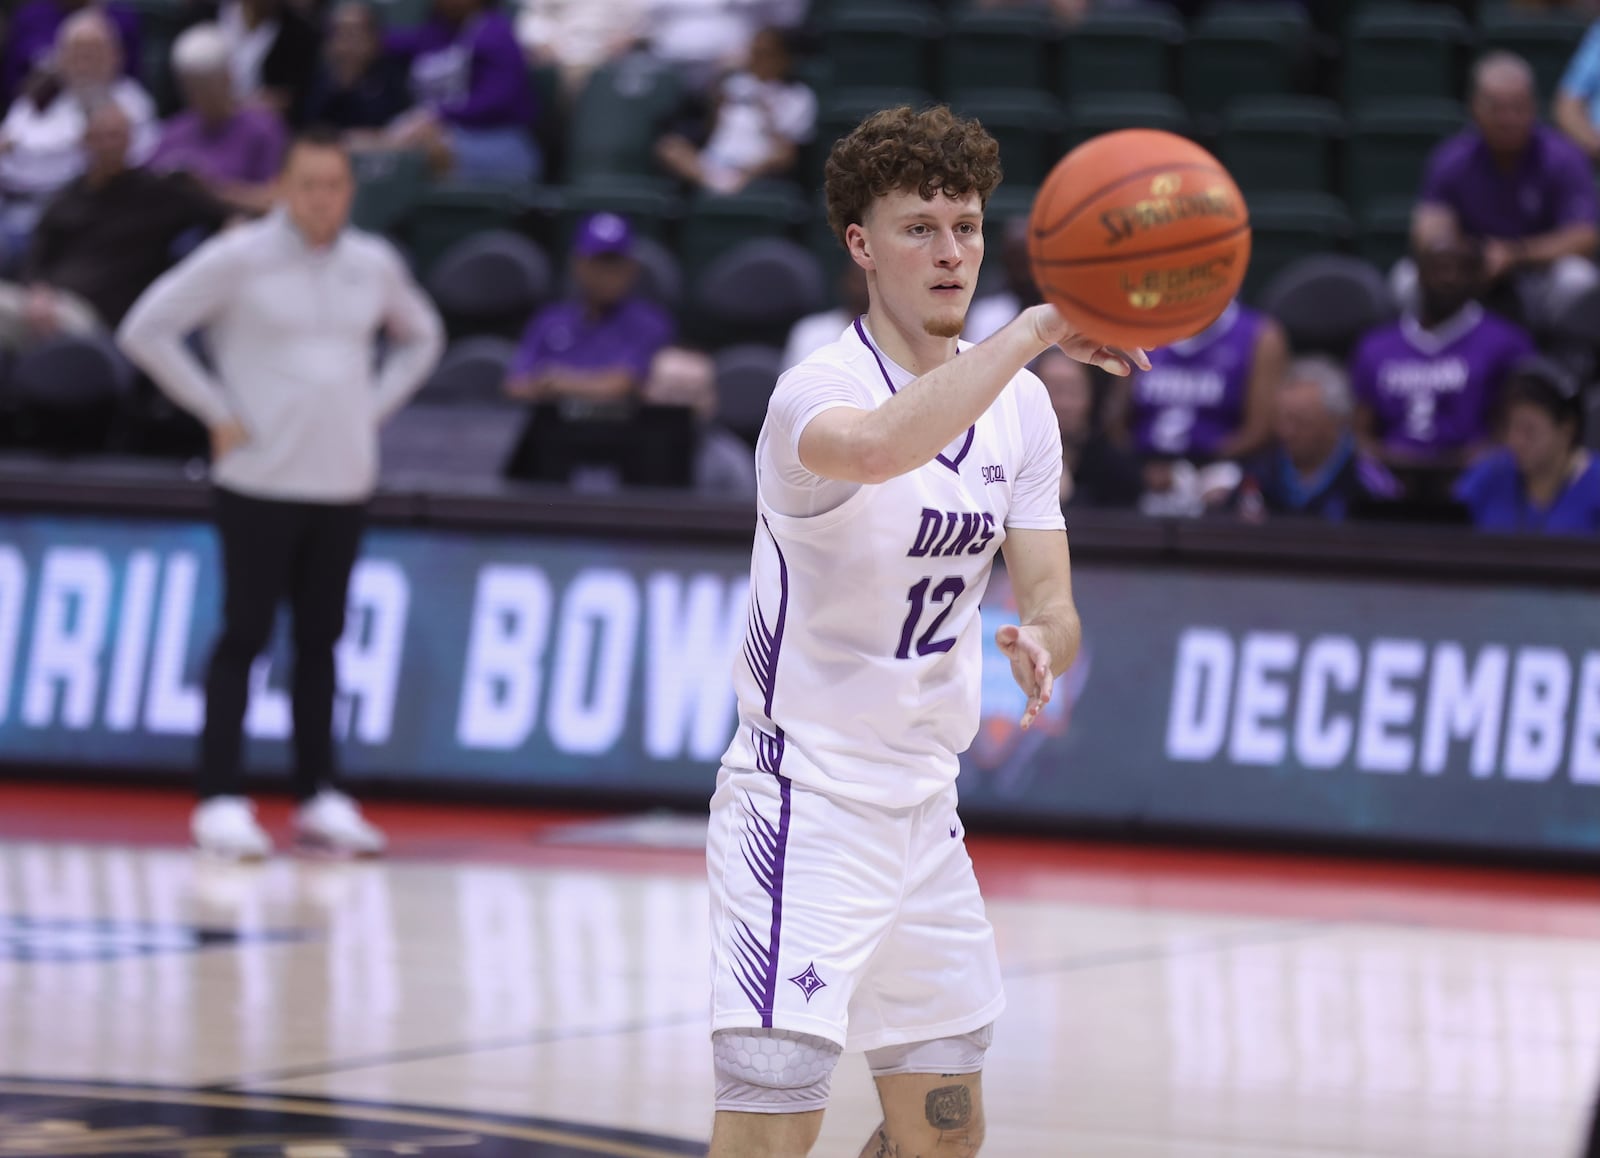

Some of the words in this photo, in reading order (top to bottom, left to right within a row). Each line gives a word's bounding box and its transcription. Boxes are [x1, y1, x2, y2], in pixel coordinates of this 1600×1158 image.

[1100, 187, 1236, 243] SPALDING
[907, 507, 996, 557] DINS
[895, 576, 965, 659] 12
[805, 976, 815, 988] F
